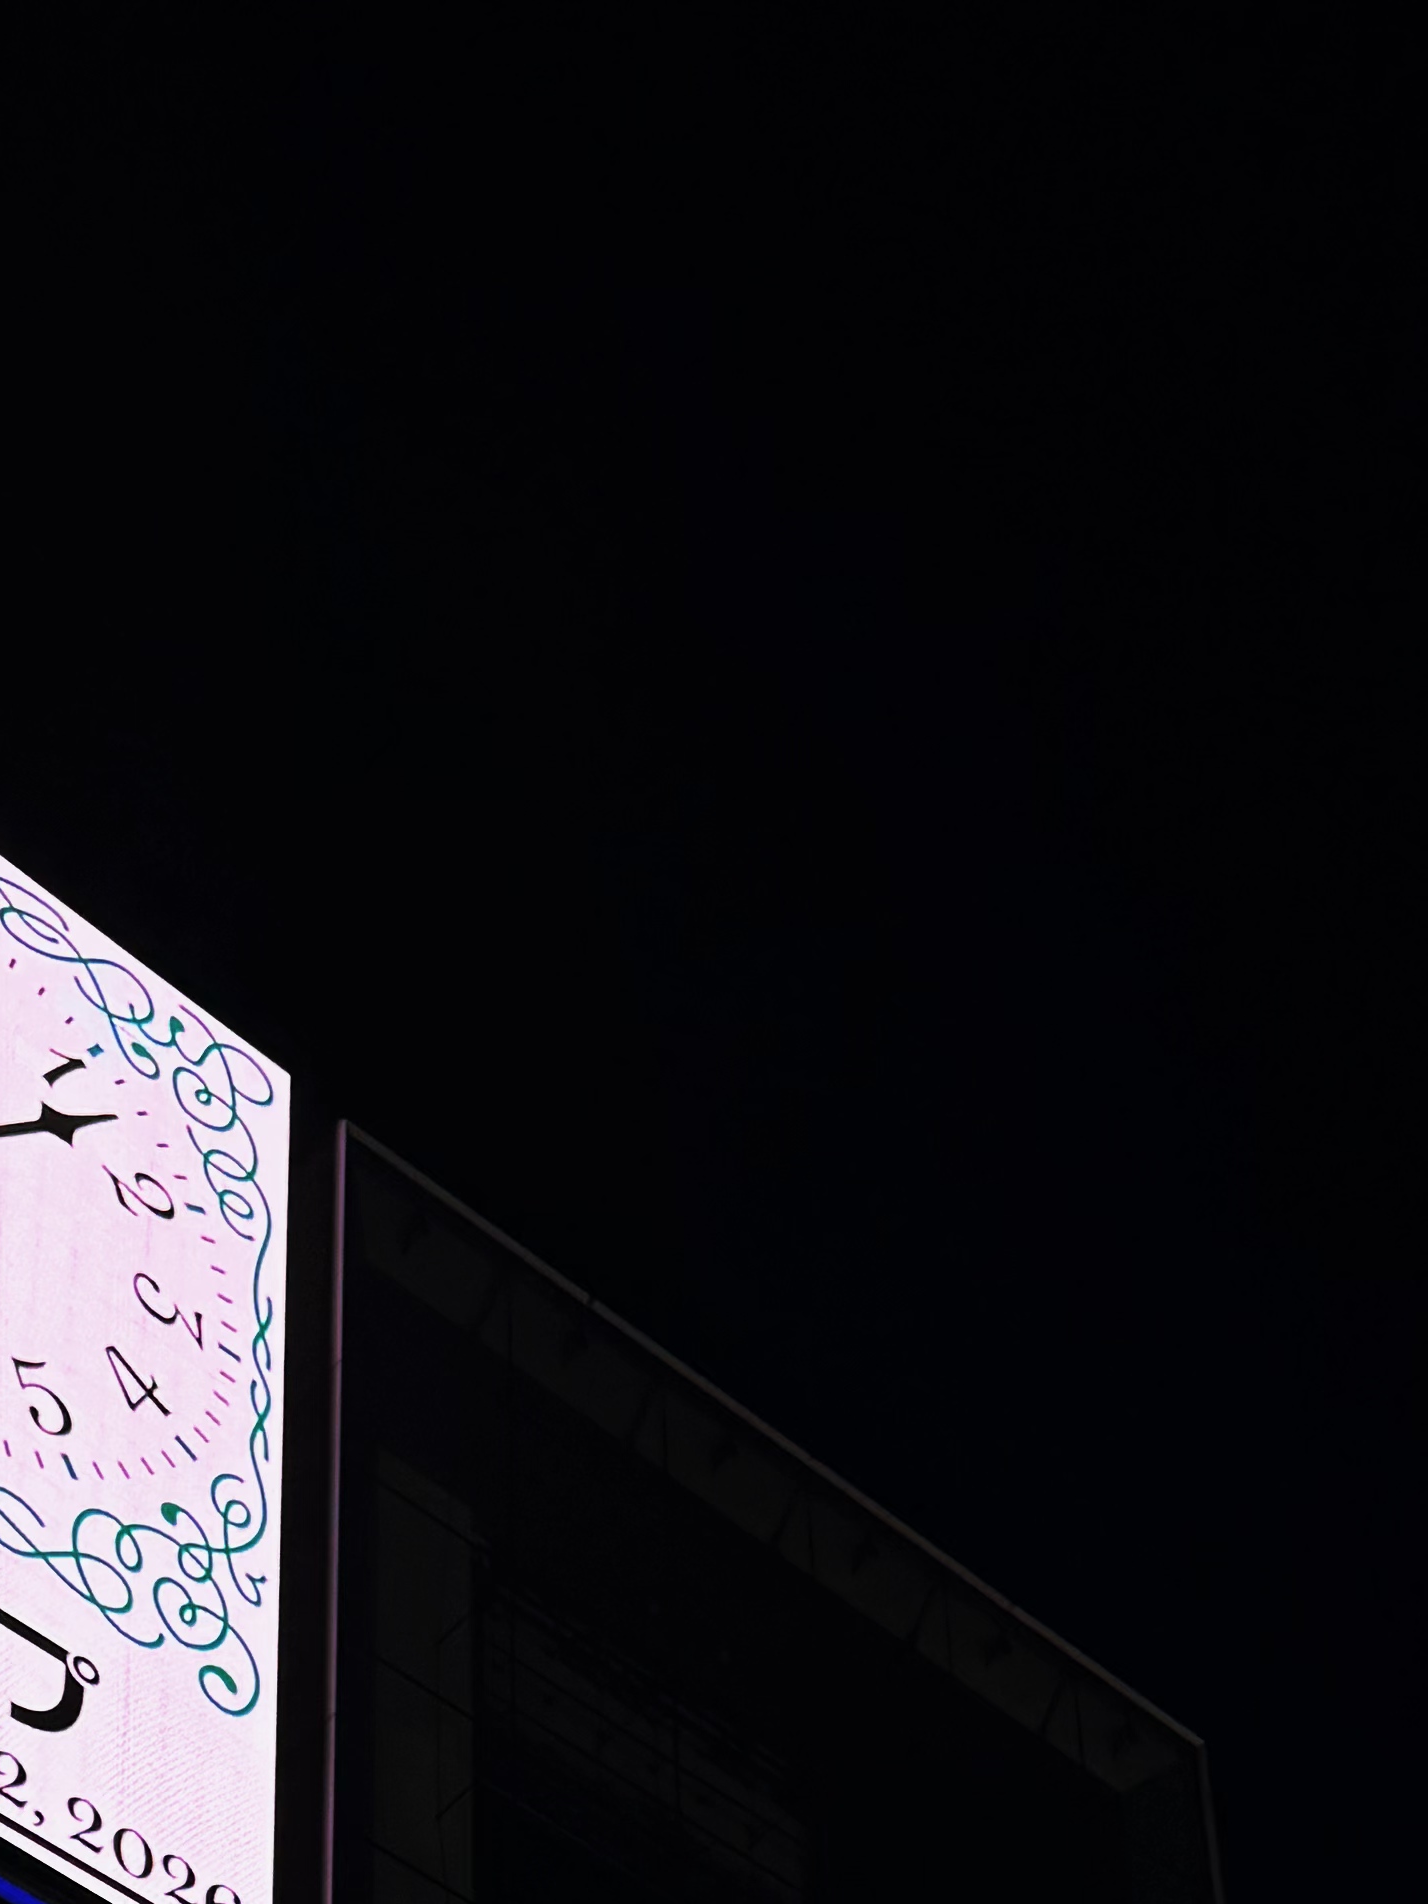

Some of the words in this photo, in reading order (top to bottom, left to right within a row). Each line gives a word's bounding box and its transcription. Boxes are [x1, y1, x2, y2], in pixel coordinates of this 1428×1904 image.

[43, 1049, 87, 1087] 1
[104, 1164, 175, 1219] 2
[132, 1270, 202, 1348] 3
[12, 1356, 72, 1436] 5
[104, 1344, 171, 1416] 4
